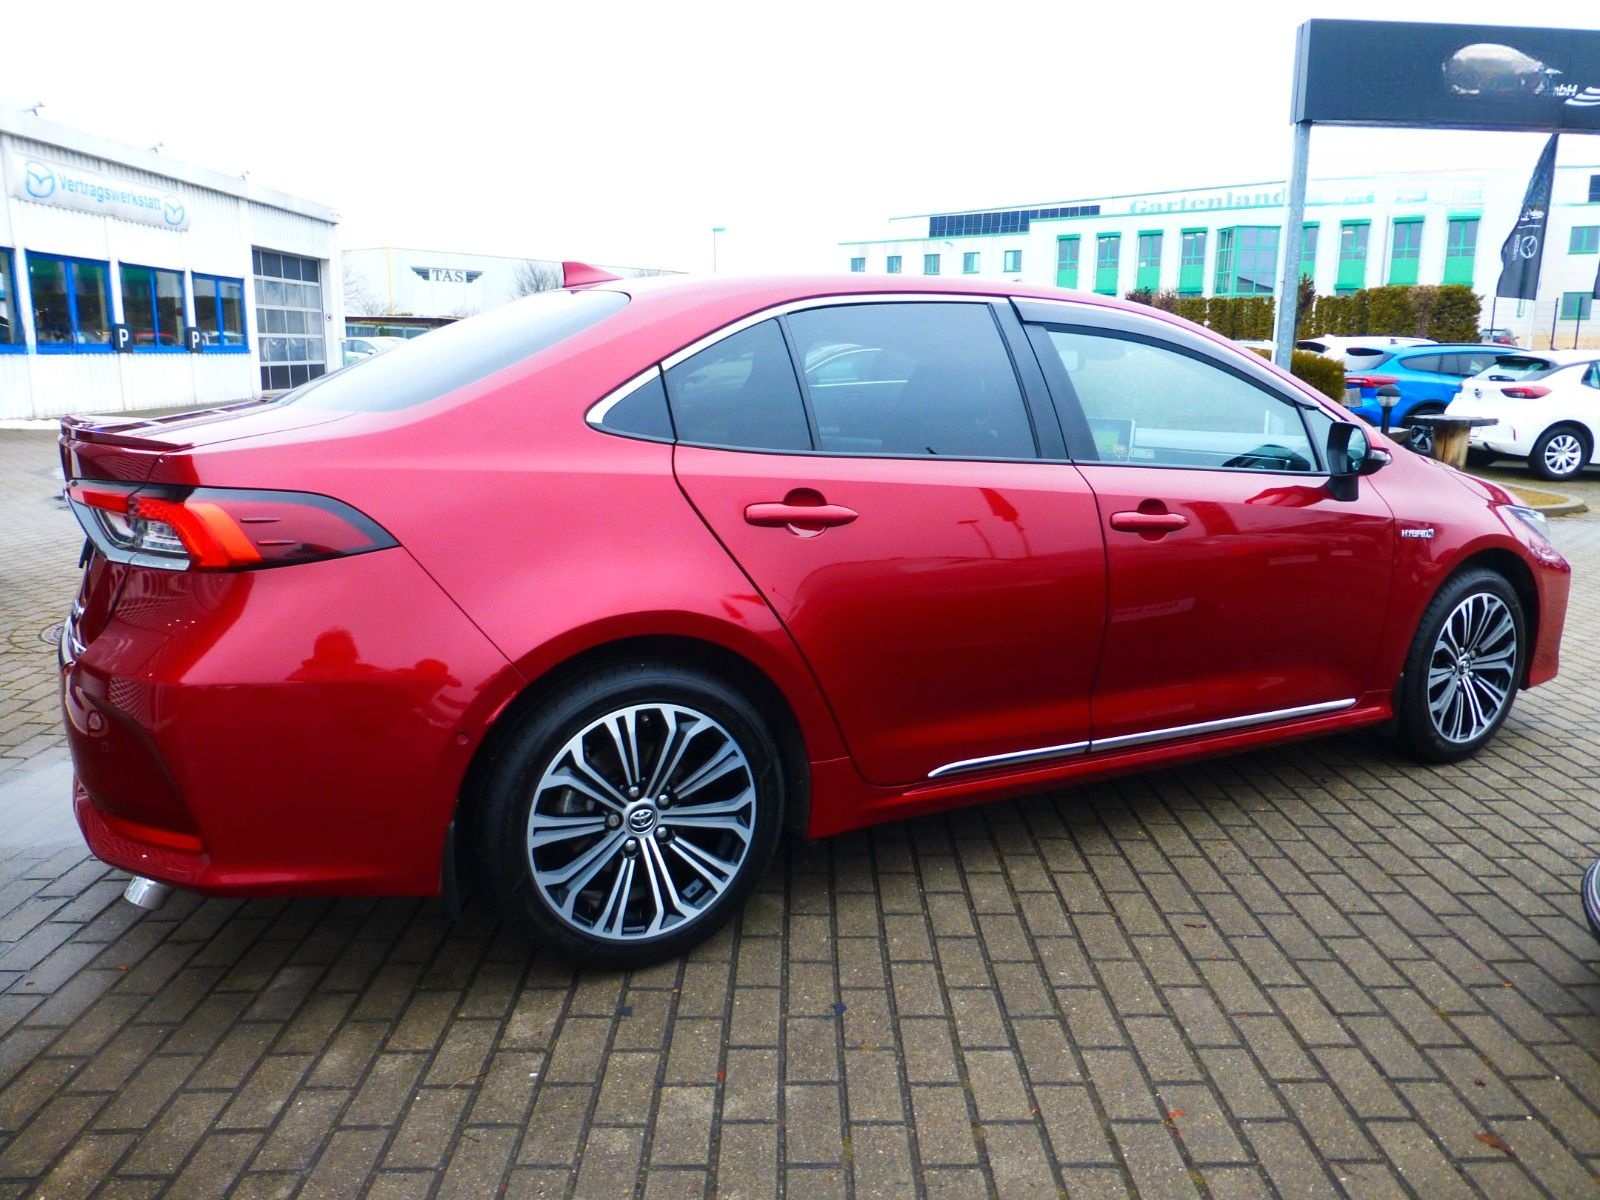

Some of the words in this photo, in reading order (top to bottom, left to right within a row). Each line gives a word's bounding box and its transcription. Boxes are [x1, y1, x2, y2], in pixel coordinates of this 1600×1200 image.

[58, 172, 161, 210] Vertragswerkstatt
[431, 269, 465, 283] TAS
[118, 328, 129, 348] P
[191, 330, 200, 350] P
[1401, 529, 1429, 538] HYBRID
